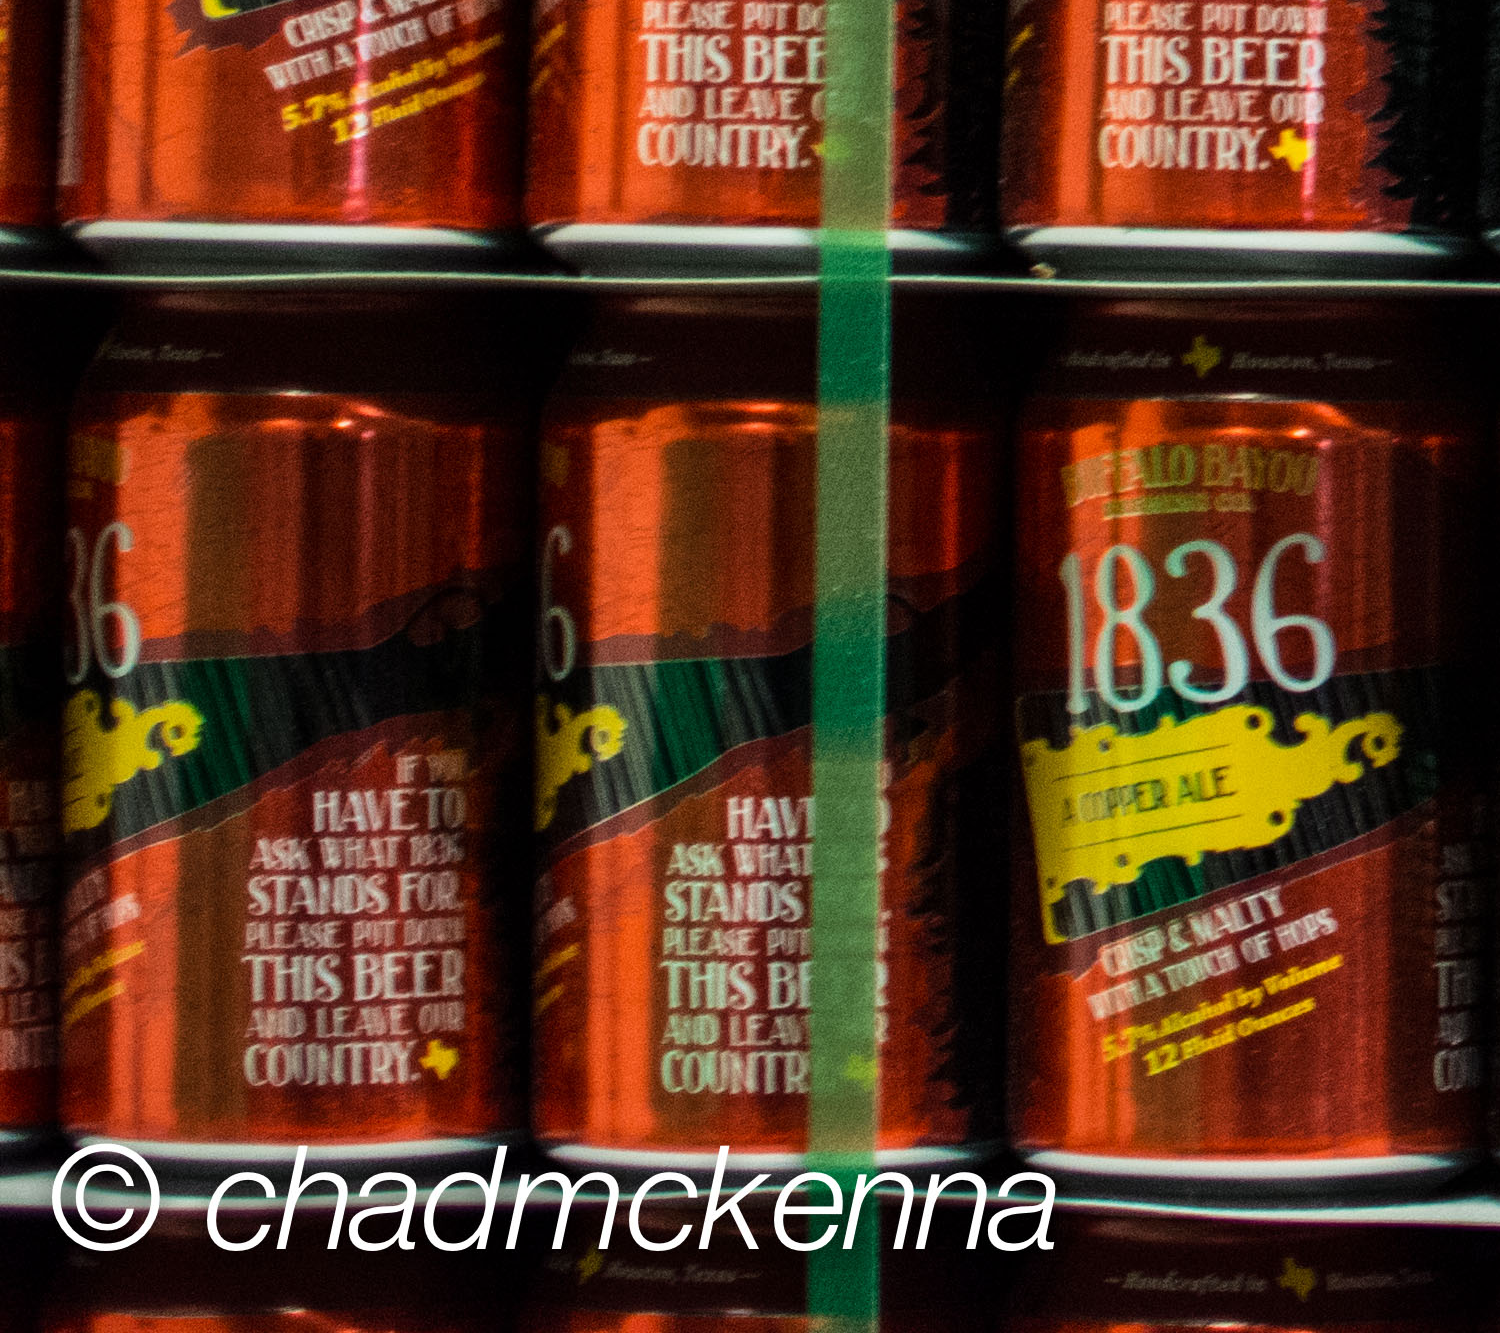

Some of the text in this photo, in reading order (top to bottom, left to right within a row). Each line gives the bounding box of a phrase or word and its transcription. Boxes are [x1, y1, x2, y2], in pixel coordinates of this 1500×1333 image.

[639, 36, 730, 82] THIS
[1101, 40, 1324, 85] THIS BEER
[1060, 533, 1335, 713] 1836
[313, 790, 465, 831] HAVE TO
[1078, 766, 1235, 823] COPPER ALE
[248, 877, 388, 914] STANDS
[243, 953, 464, 1003] THIS BEER
